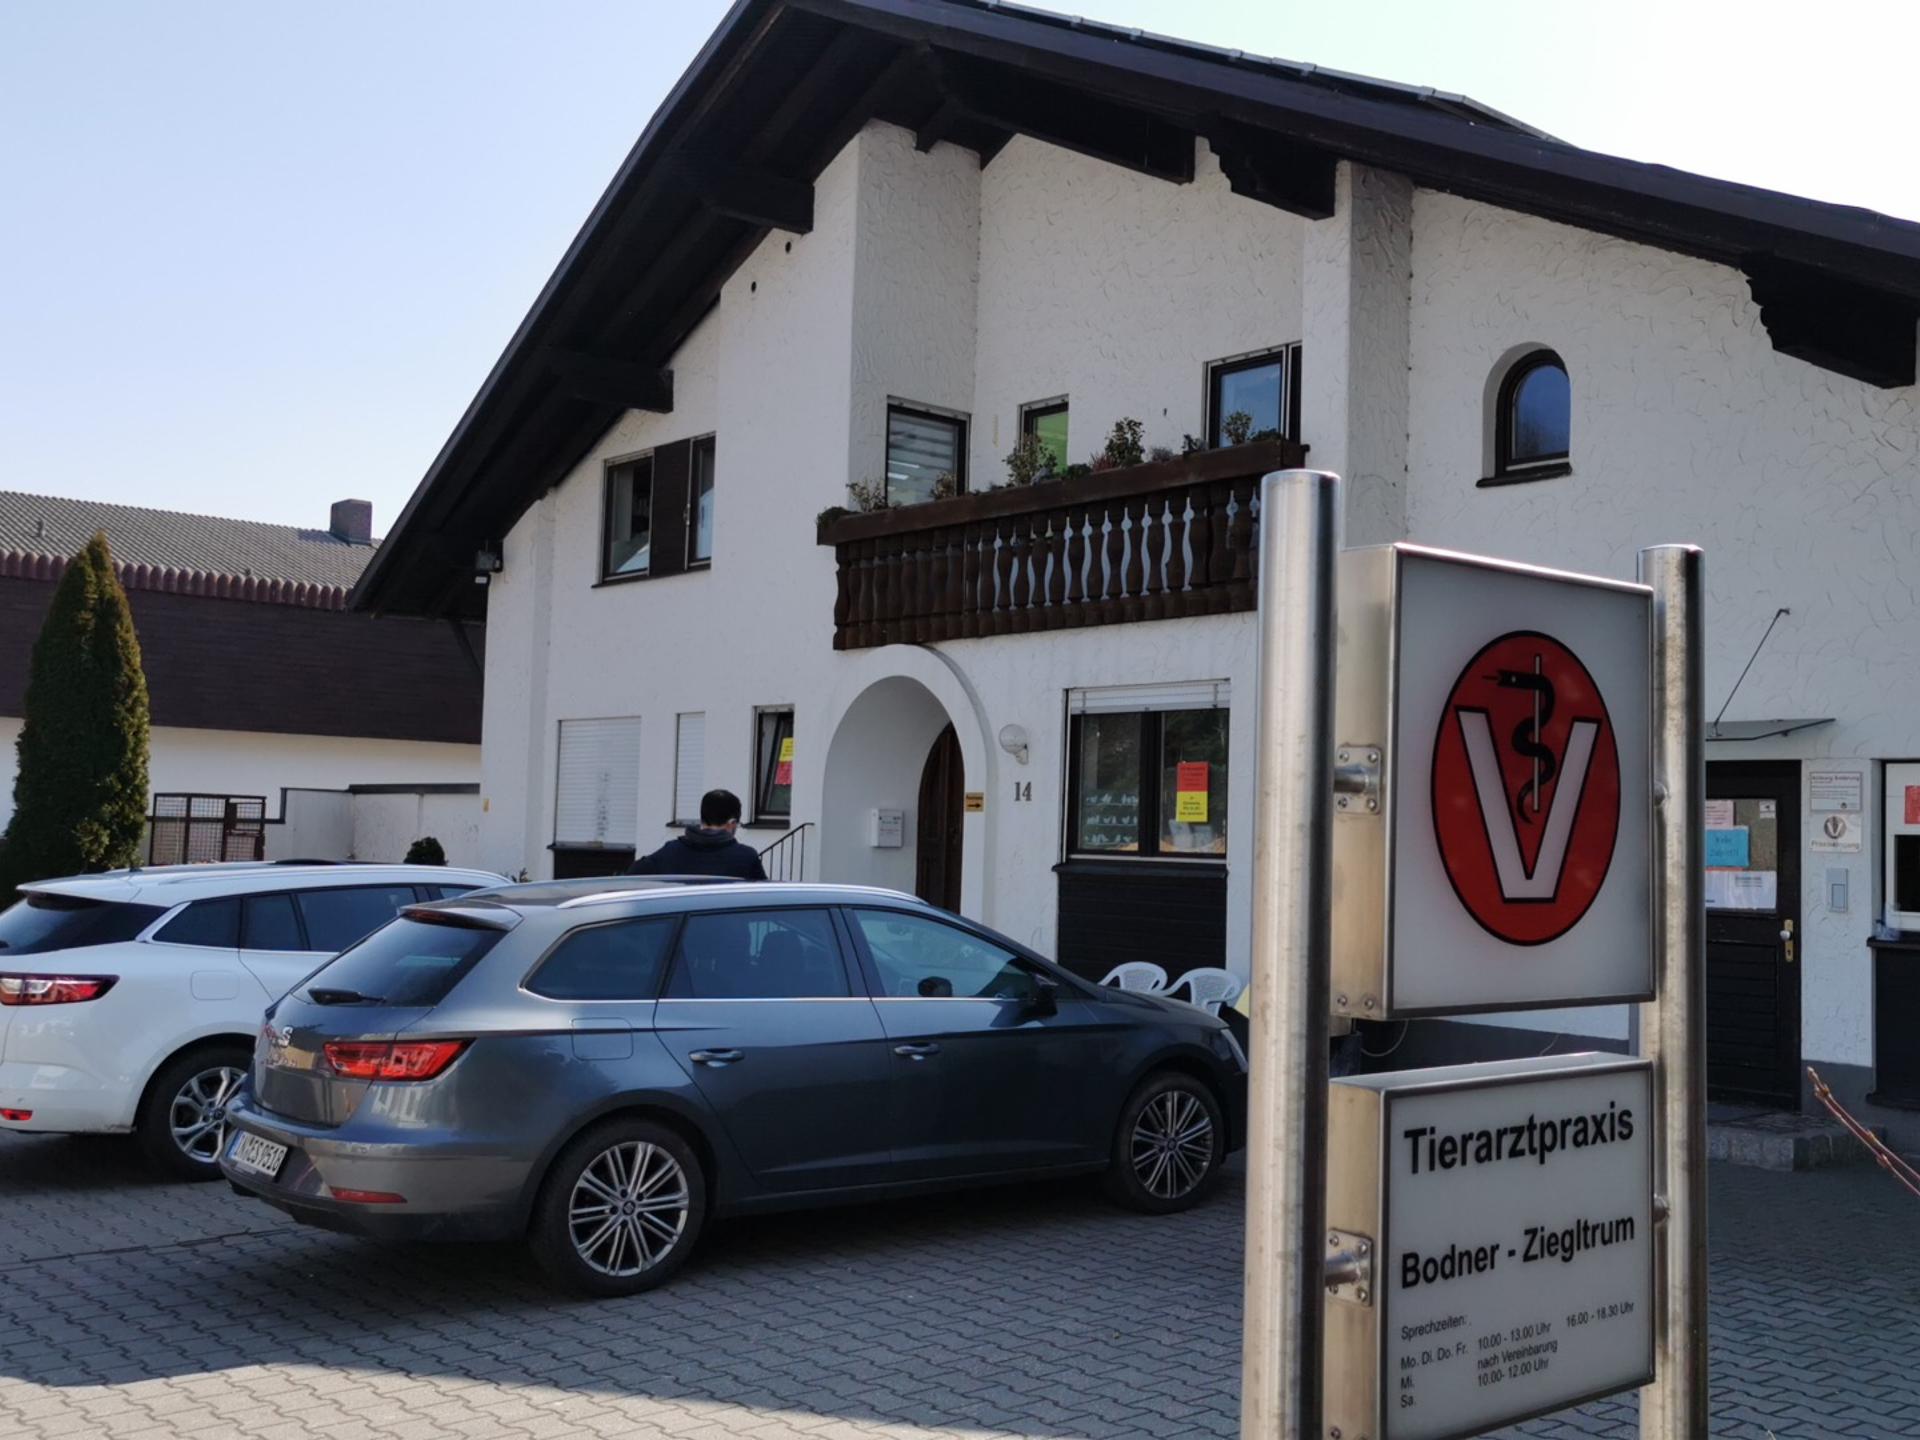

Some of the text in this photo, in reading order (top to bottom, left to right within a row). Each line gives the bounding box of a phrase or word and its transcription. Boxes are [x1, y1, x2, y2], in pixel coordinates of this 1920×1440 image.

[1015, 781, 1032, 802] 14
[1455, 705, 1602, 904] V
[1403, 1101, 1634, 1174] Tierarztpraxis
[1401, 1244, 1500, 1289] Bodner
[1522, 1216, 1635, 1263] Ziegltrum
[1478, 1333, 1502, 1350] 10.00
[1511, 1325, 1534, 1342] 13.00
[1535, 1322, 1552, 1336] Uhr
[1566, 1311, 1589, 1328] 16.00
[1597, 1303, 1619, 1320] 18.30
[1620, 1301, 1635, 1315] Uhr
[1477, 1353, 1499, 1370] nach
[1501, 1340, 1558, 1364] Vereinbarung
[1508, 1361, 1532, 1379] 12.00
[1534, 1357, 1550, 1372] Uhr
